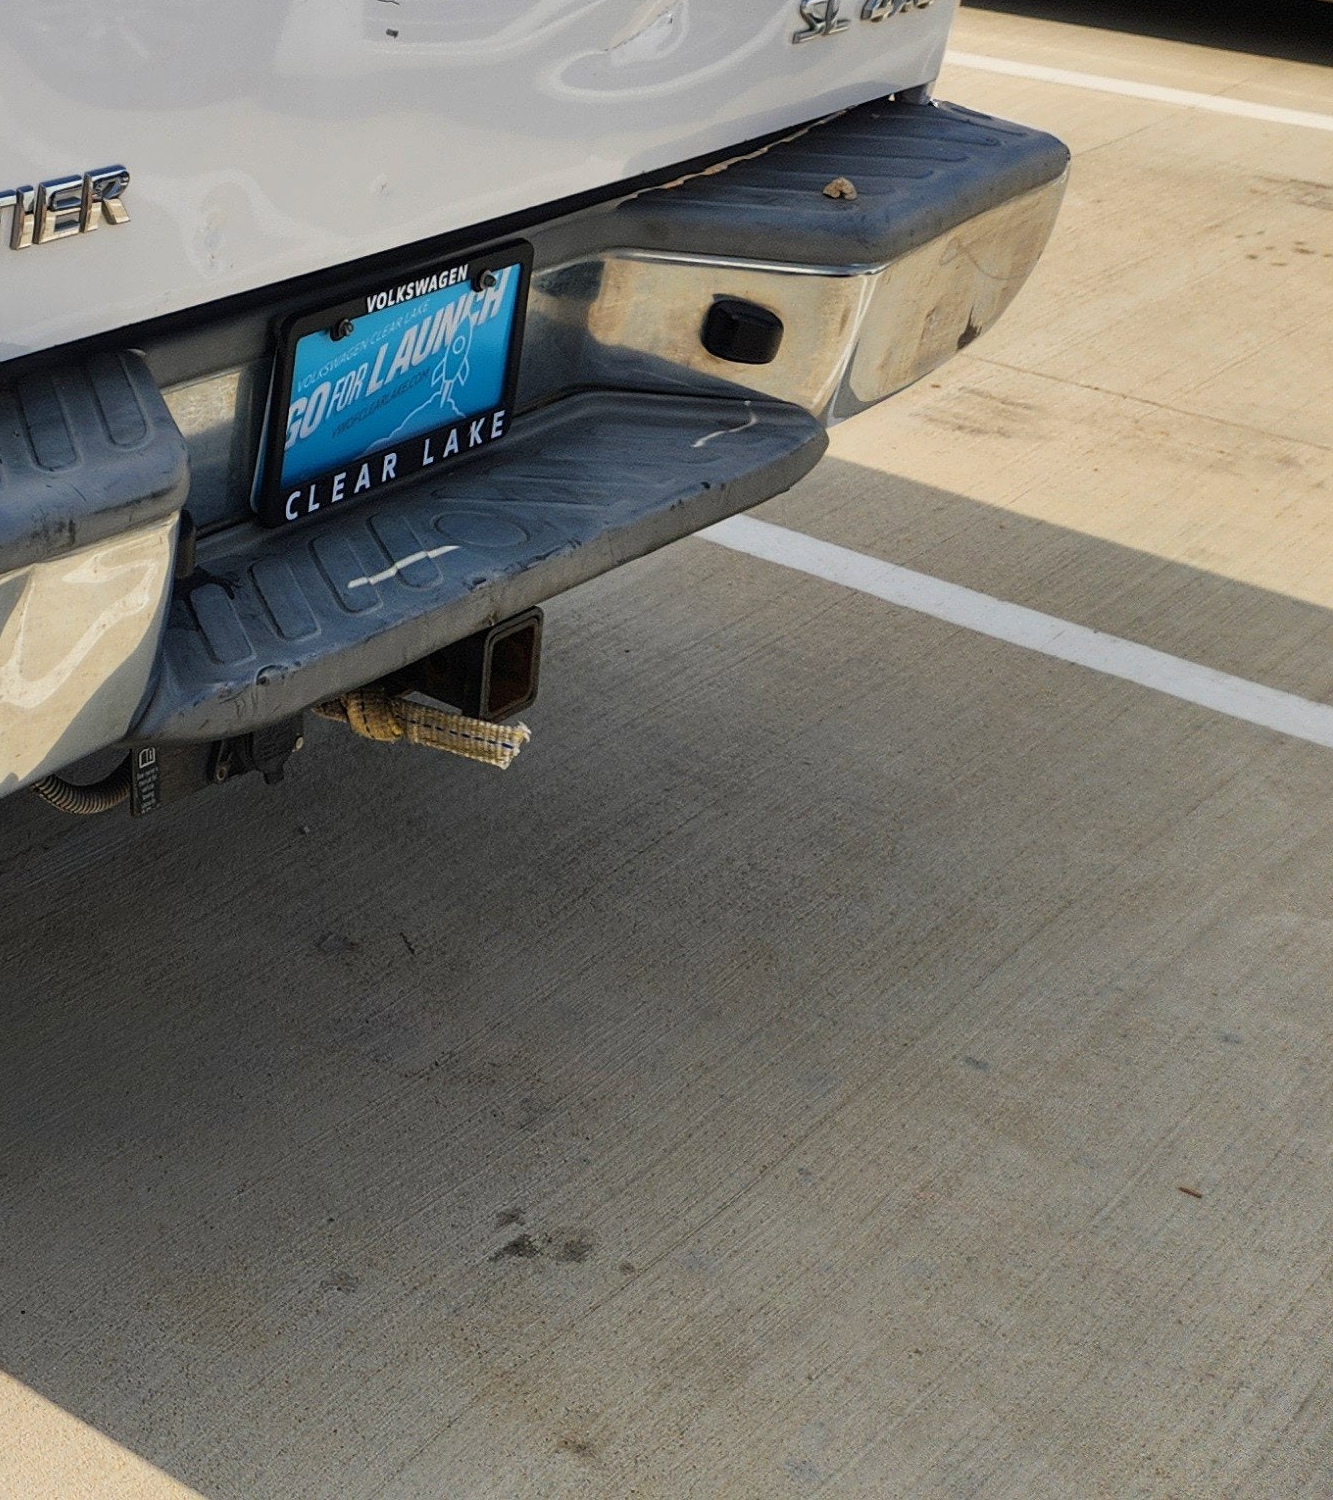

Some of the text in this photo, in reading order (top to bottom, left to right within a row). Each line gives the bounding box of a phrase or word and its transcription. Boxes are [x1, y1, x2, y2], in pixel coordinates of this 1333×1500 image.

[366, 264, 469, 313] VOLKSWAGEN
[284, 267, 512, 450] GO FOR LAUNCH
[285, 410, 506, 521] CLEAR LAKE
